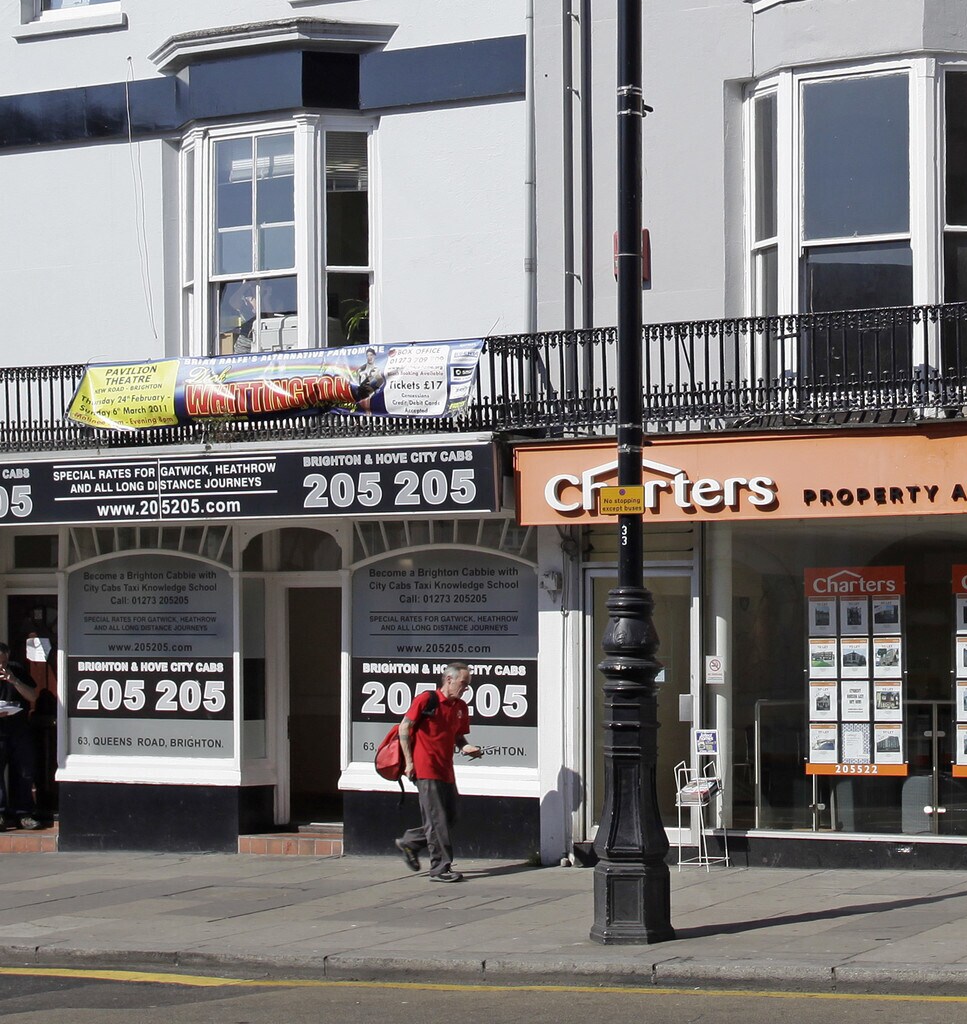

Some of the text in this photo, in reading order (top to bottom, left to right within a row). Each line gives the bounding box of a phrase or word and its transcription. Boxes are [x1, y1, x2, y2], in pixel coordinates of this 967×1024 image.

[184, 352, 323, 366] BRIAN RALFE'S ALTERNATIVE
[105, 366, 158, 376] PAVILION
[106, 375, 151, 385] THEATRE
[390, 381, 442, 389] Tickets £17
[131, 395, 165, 404] February
[185, 376, 356, 415] WHITTINGTON
[124, 406, 146, 414] March
[303, 450, 473, 467] BRIGHTON & HOVE CITY CABS
[2, 468, 30, 479] CABS
[53, 463, 276, 481] SPECIAL RATES FOR GATWICK, HEATHROW
[70, 477, 262, 493] AND ALL LONG DISTANCE JOURNEYS
[303, 469, 476, 508] 205 205
[544, 467, 776, 511] Chrters
[804, 485, 939, 506] PROPERTY
[97, 499, 241, 516] www.205205.com
[84, 572, 117, 580] Become
[127, 572, 164, 581] Brighton
[166, 571, 196, 579] Cabbie
[199, 571, 216, 579] with
[369, 569, 406, 577] Become
[418, 568, 455, 578] Brighton
[462, 568, 495, 576] Cabbie
[498, 567, 518, 575] with
[84, 584, 99, 593] City
[102, 584, 121, 592] Cabs
[142, 584, 186, 592] Knowledge
[189, 583, 216, 591] School
[369, 582, 385, 591] City
[435, 581, 484, 591] Knowledge
[487, 581, 518, 589] School
[813, 575, 895, 592] Charters
[111, 597, 129, 605] Call:
[132, 597, 156, 605] 01273
[399, 595, 420, 603] Call:
[423, 595, 450, 603] 01273
[108, 643, 192, 652] www.205205.com
[397, 644, 491, 653] www.205205.com
[78, 662, 224, 672] BRIGHTON & HOVE CITY CABS
[363, 663, 526, 676] BRIGHTON & CITY CABS
[77, 679, 225, 712] 205 205
[78, 737, 223, 748] 63, QUEENS ROAD, BRIGHTON.
[363, 742, 376, 751] 63,
[835, 765, 878, 774] 205522
